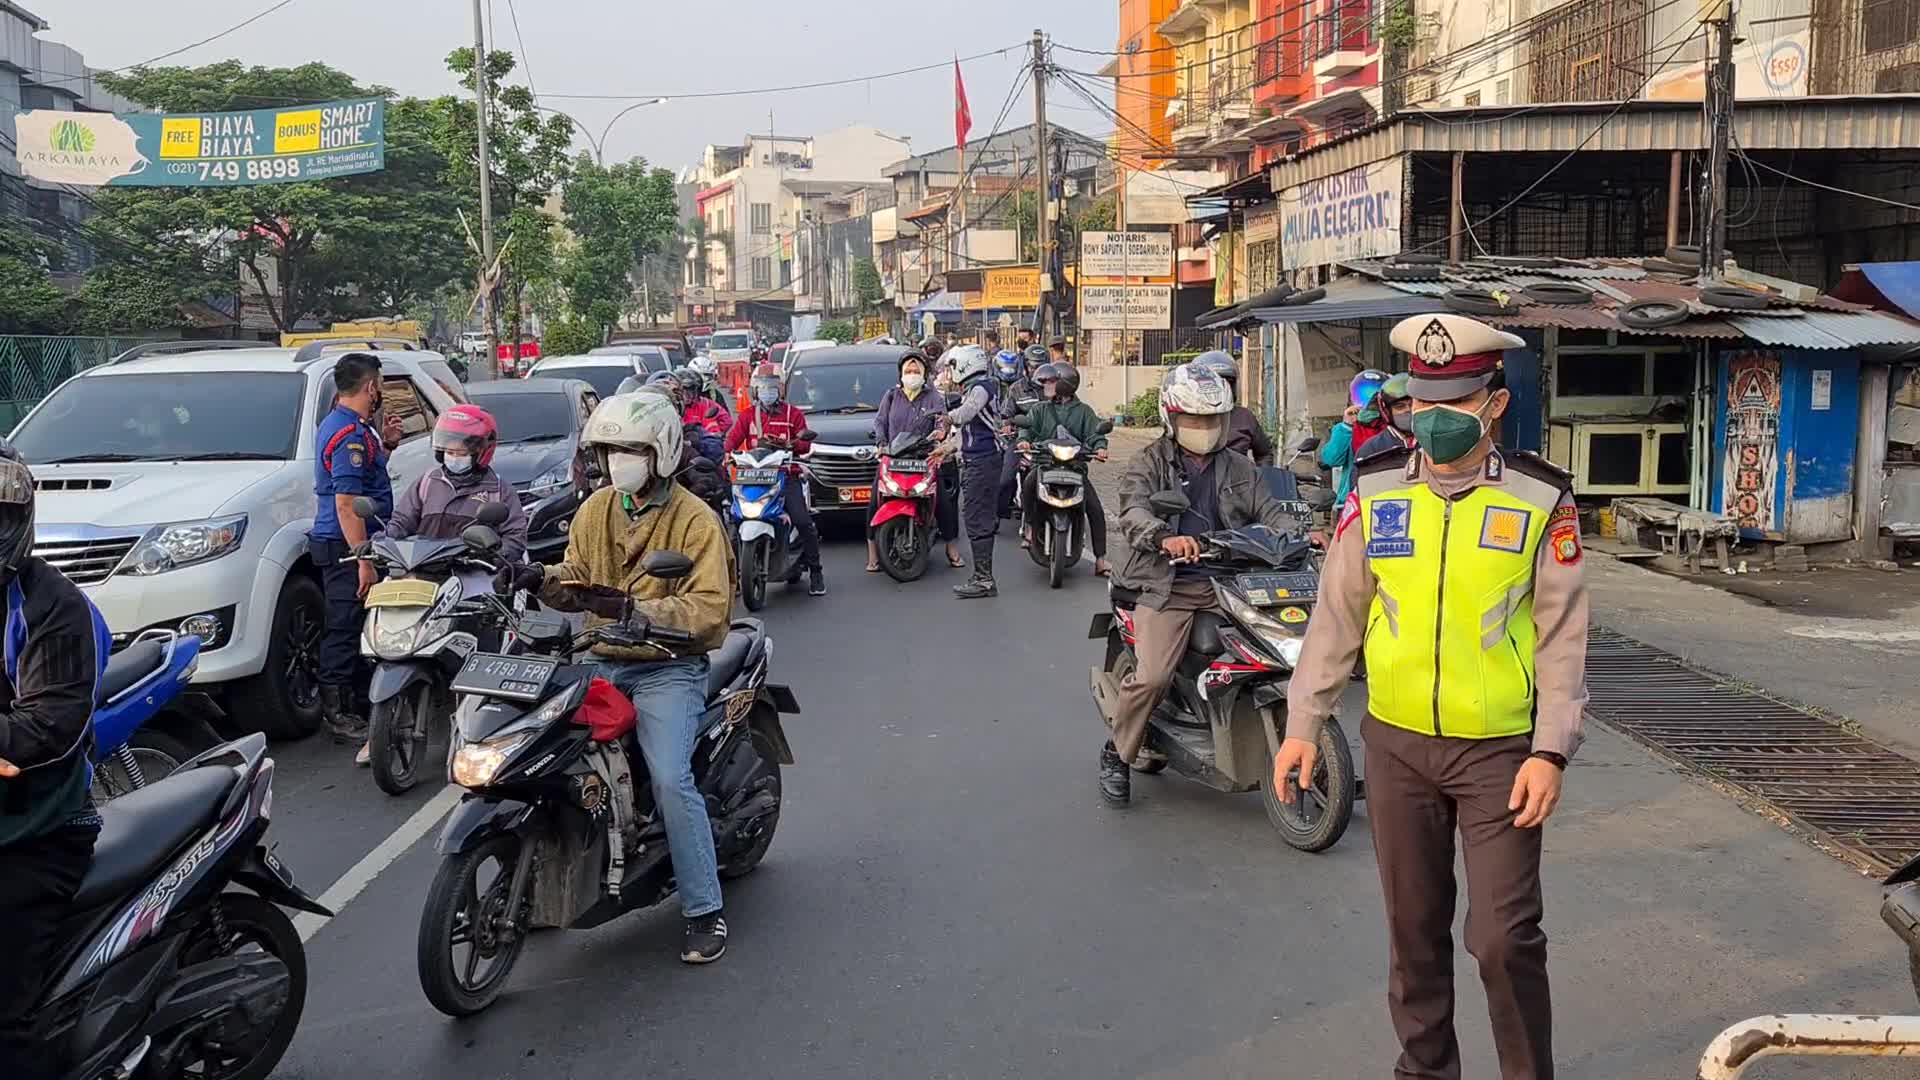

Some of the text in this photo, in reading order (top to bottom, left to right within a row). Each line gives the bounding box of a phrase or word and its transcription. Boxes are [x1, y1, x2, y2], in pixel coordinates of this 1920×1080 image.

[166, 102, 377, 143] FREE BIAYA BONUS SMART
[200, 136, 254, 157] BIAYA
[23, 151, 119, 166] ARKAMAYA
[167, 157, 300, 182] (021) 749 8898
[1284, 208, 1321, 244] MULIA
[1101, 243, 1124, 255] SAPUTR
[1109, 288, 1134, 297] PEMBAT
[1101, 305, 1124, 314] SAPUTR
[468, 659, 549, 680] B 4798 FPR
[524, 753, 556, 776] HONDA
